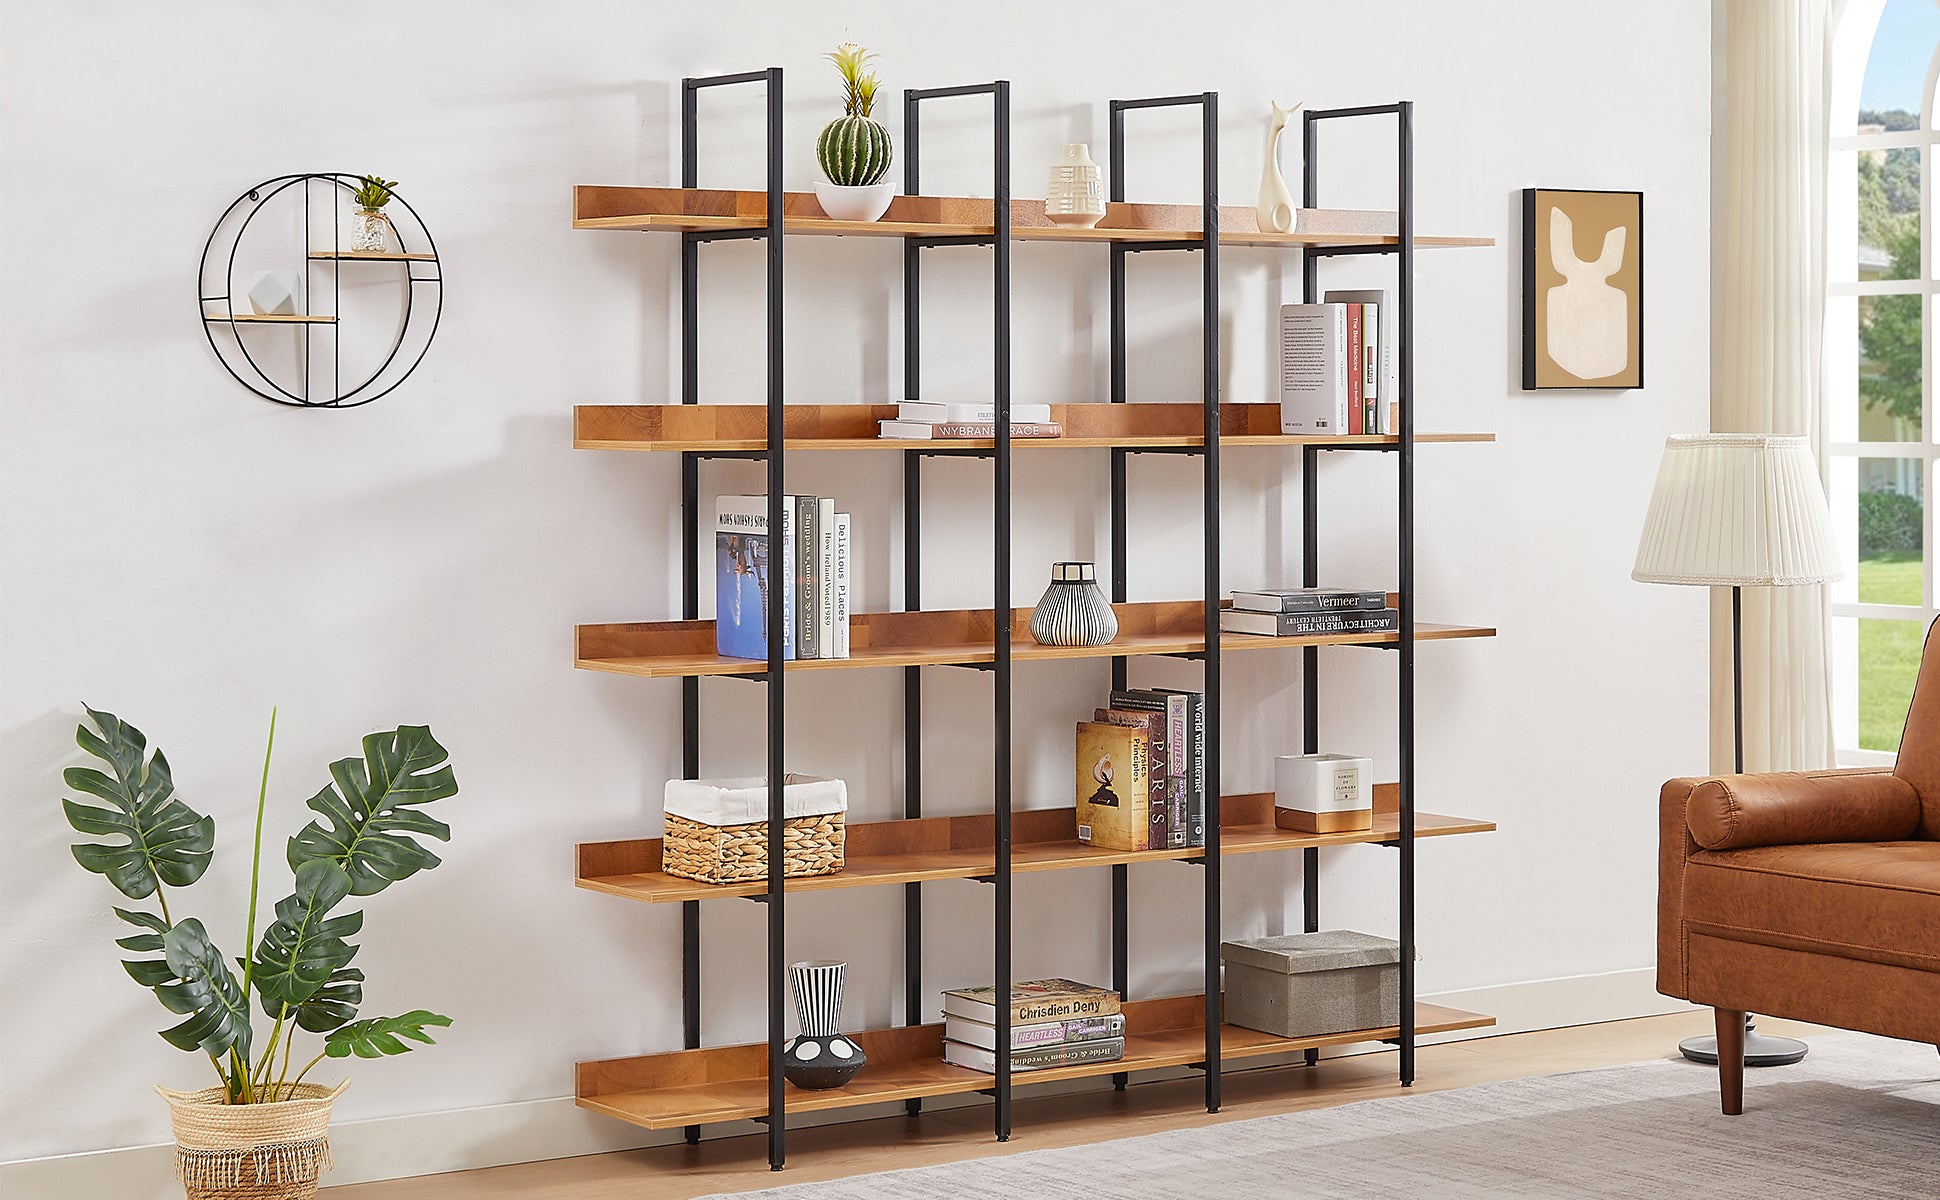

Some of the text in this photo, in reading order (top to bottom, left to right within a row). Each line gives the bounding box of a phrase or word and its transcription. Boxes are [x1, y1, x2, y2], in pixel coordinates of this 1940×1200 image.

[1010, 426, 1039, 435] RACE
[804, 513, 812, 554] wedding
[804, 556, 812, 599] Groom's
[838, 524, 846, 621] Delicious Places
[805, 602, 812, 611] &
[1318, 595, 1360, 608] Vermeer
[1297, 623, 1315, 632] THE
[1195, 702, 1203, 731] World
[1140, 742, 1148, 777] Physics
[1174, 721, 1182, 774] HEARTLESS
[1152, 740, 1164, 823] PARIS
[1195, 757, 1203, 793] internet
[1019, 1001, 1101, 1019] Chrisdien Deny
[1018, 1028, 1063, 1042] HEARTLESS
